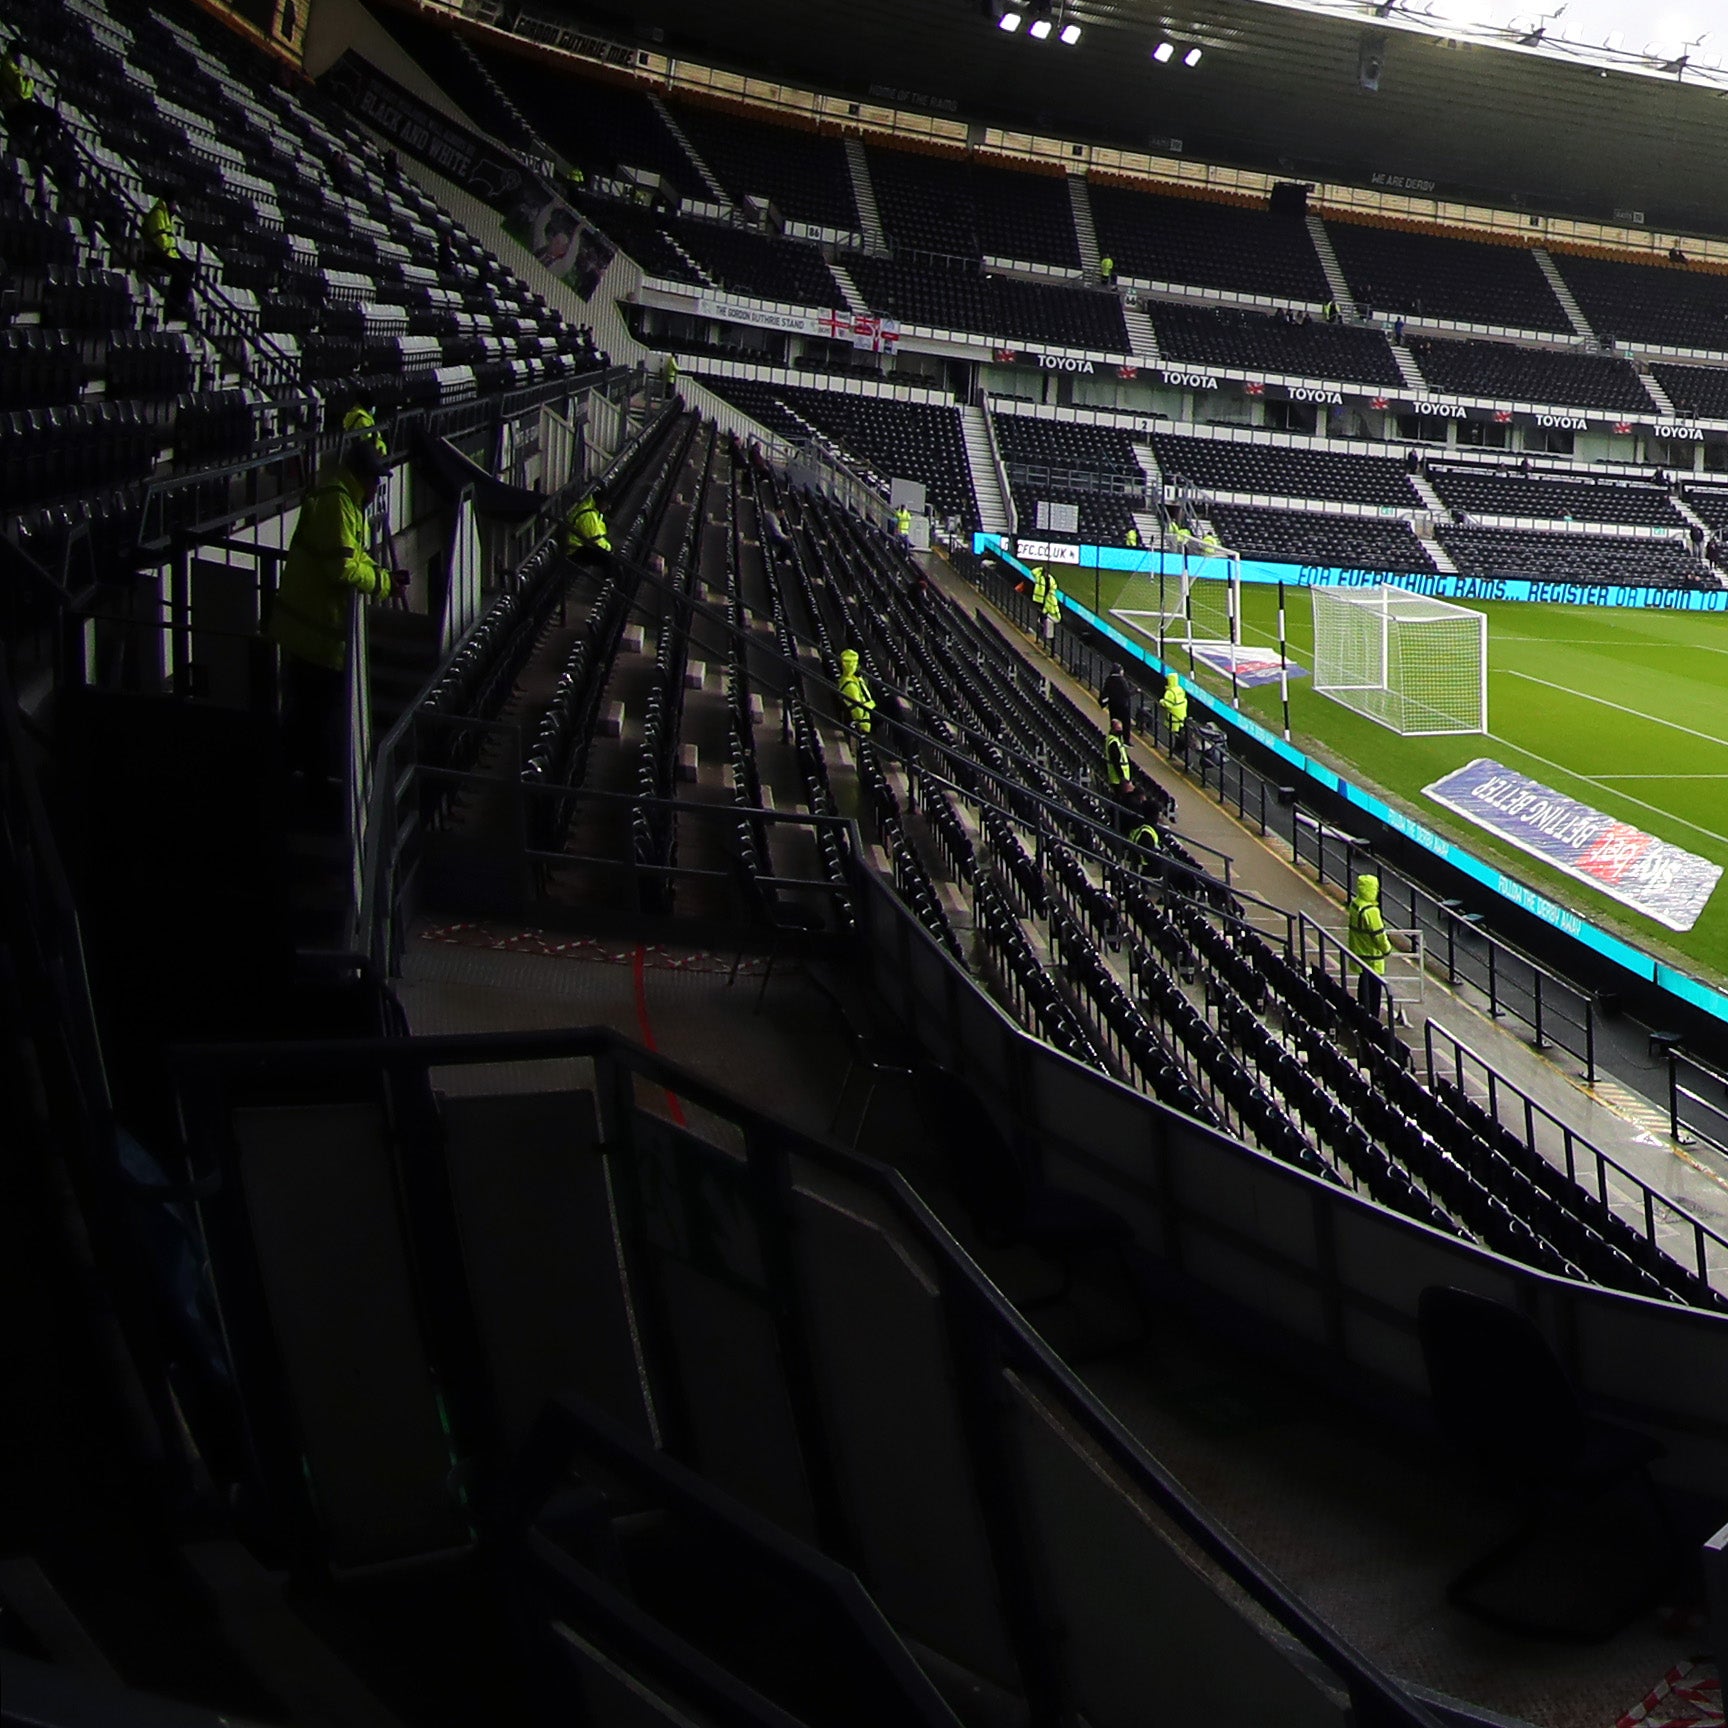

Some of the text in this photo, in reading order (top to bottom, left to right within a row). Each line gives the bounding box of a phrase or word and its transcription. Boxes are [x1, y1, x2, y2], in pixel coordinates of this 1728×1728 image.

[559, 30, 607, 58] GUTHRIE
[359, 90, 401, 133] BLACK
[400, 119, 430, 152] AND
[429, 135, 473, 178] WHITE
[1386, 176, 1404, 188] ARE
[1405, 179, 1435, 192] DERBY
[781, 317, 804, 333] STAND
[1038, 354, 1094, 374] TOYOTA
[1162, 370, 1218, 389] TOYOTA
[1288, 386, 1343, 404] TOYOTA
[1413, 401, 1467, 419] TOYOTA
[1535, 414, 1587, 431] TOYOTA
[1654, 424, 1704, 440] TOYOTA
[1300, 566, 1331, 587] FOR
[1339, 568, 1448, 597] EVERYTHING
[1528, 582, 1608, 606] REGISTER
[1615, 587, 1638, 607] OR
[1644, 587, 1691, 610] LOGIN
[1699, 591, 1718, 610] TO
[1472, 775, 1600, 849] BETTING BETTER
